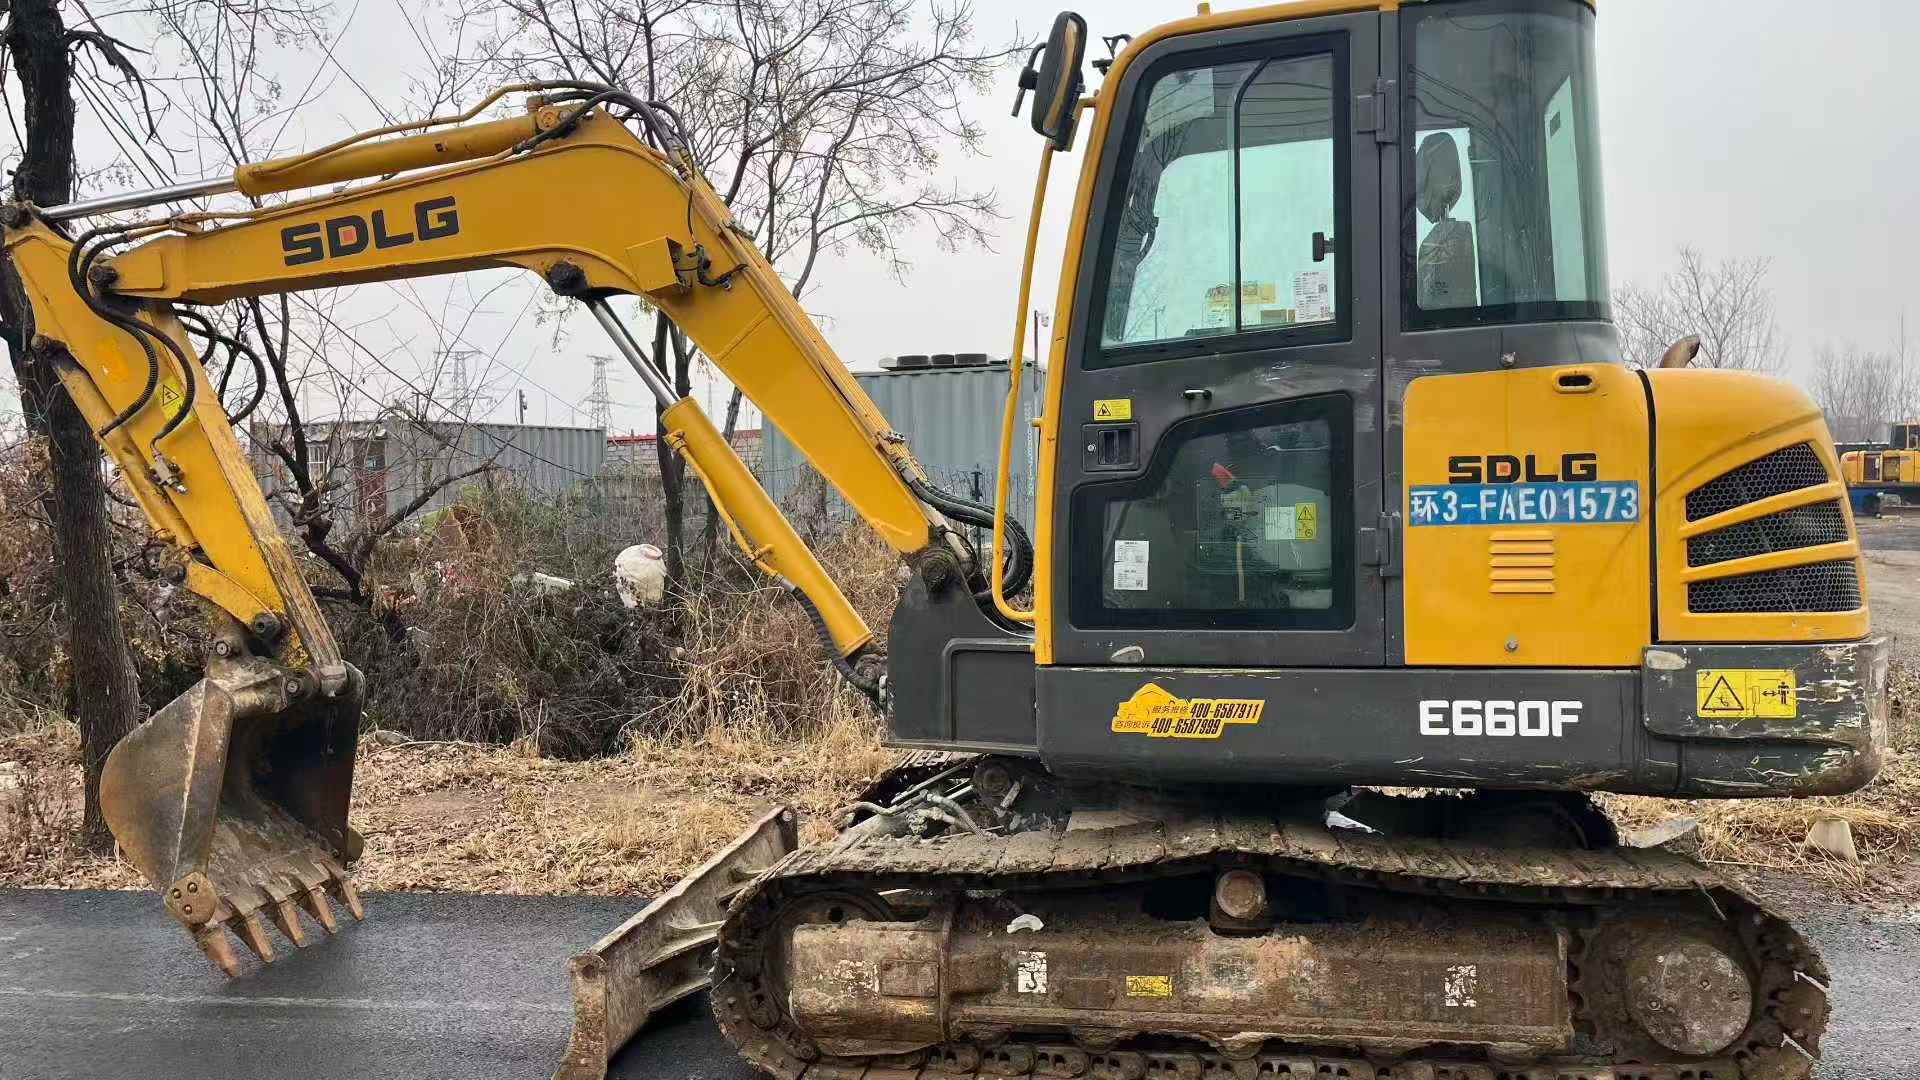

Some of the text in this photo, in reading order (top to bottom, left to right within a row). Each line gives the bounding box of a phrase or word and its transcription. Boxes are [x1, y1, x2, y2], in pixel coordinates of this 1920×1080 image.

[281, 196, 459, 266] SDLG
[1448, 453, 1596, 483] SDLG
[1411, 487, 1638, 522] 环3-FAE01573
[1151, 718, 1222, 735] 400-6587999
[1190, 703, 1260, 719] 400-6587911
[1419, 700, 1583, 737] E660F
